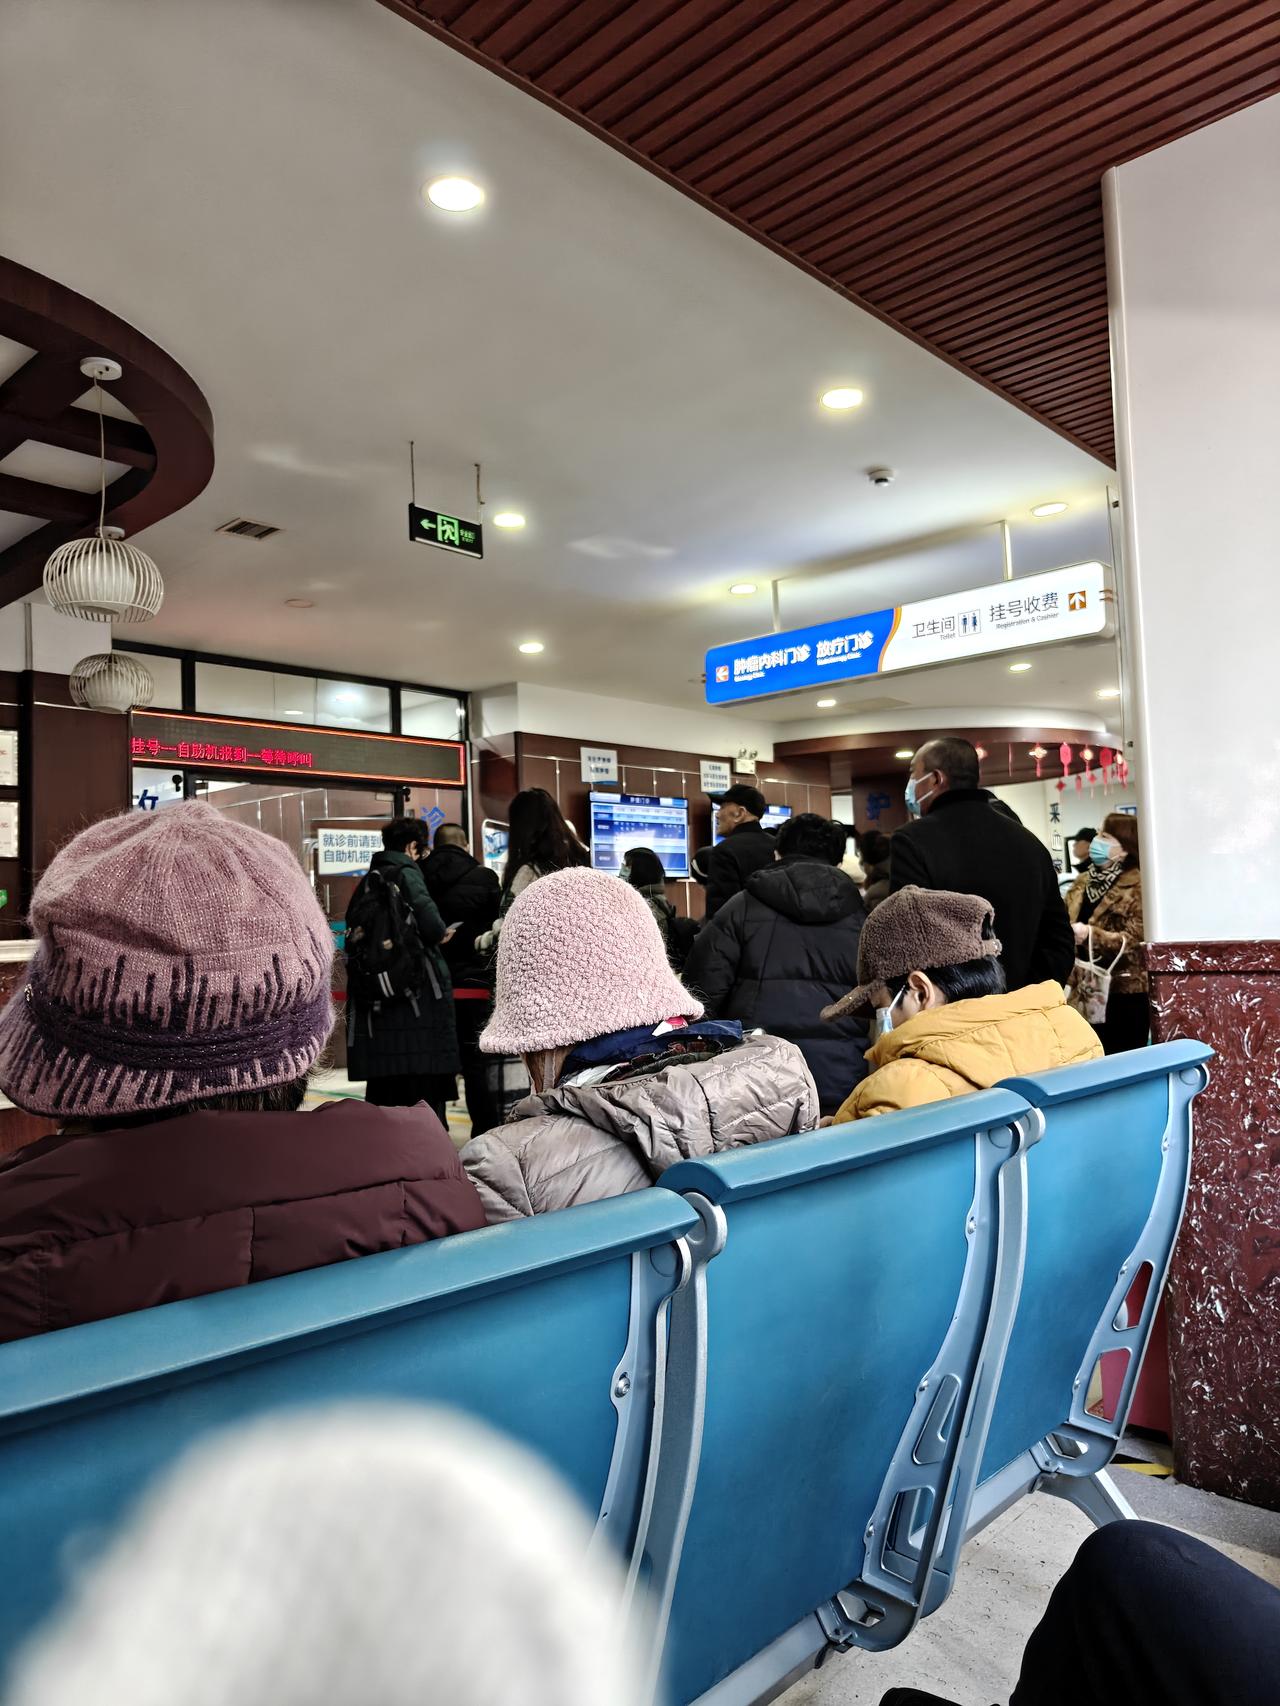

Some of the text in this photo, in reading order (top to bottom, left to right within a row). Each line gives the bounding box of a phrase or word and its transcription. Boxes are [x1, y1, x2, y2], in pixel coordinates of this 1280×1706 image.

[988, 591, 1059, 623] 挂号收费
[911, 615, 956, 639] 卫生间
[733, 642, 812, 676] 肿瘤内科门诊
[816, 629, 875, 659] 放疗门诊
[323, 850, 376, 864] 自助机报
